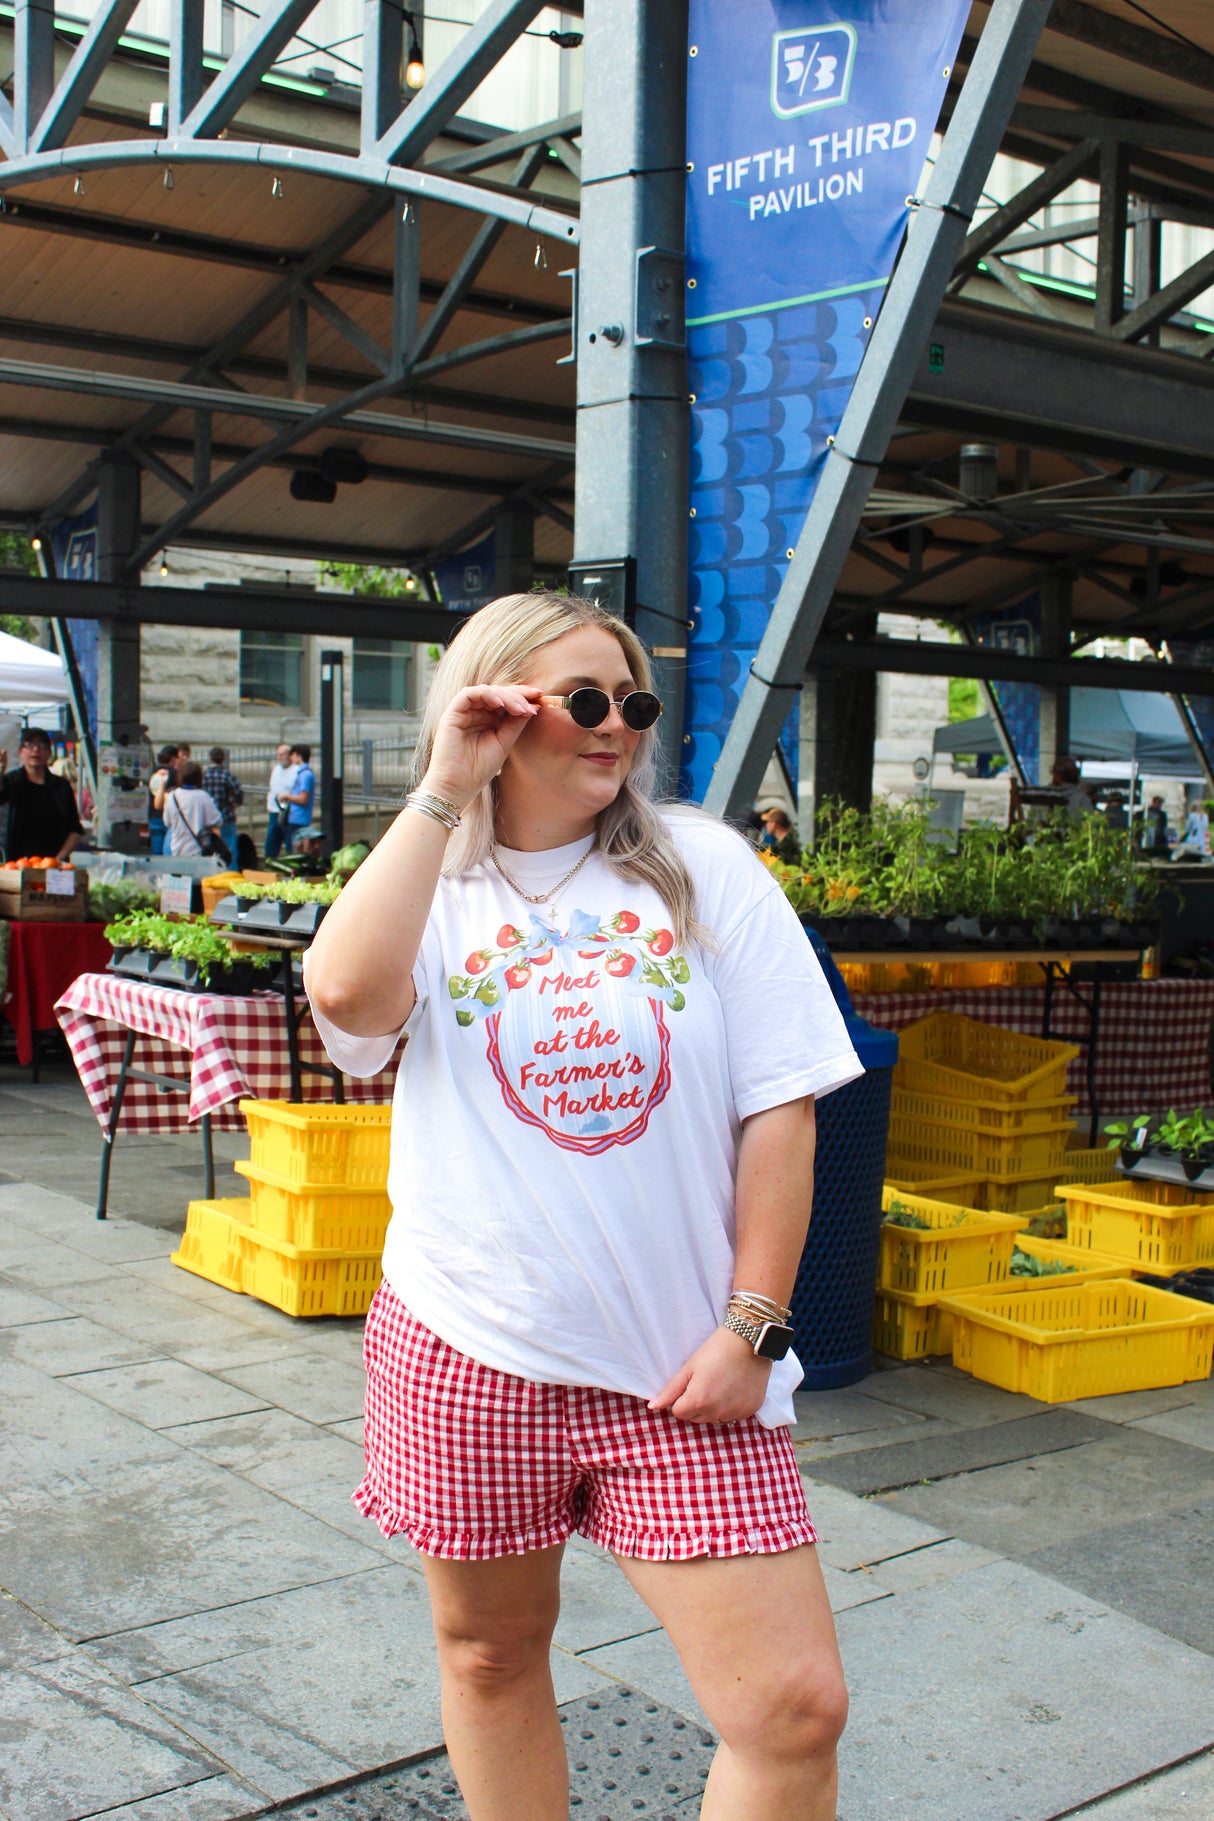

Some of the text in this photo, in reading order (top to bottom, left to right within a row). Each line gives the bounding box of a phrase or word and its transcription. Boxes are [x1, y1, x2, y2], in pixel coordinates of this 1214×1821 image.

[707, 117, 917, 196] FIFTH THIRD
[750, 168, 863, 220] PAVILION
[538, 970, 601, 995] Meet
[552, 1001, 593, 1022] me
[534, 1020, 620, 1055] at the
[520, 1052, 645, 1090] Farmer's
[543, 1083, 644, 1117] Market
